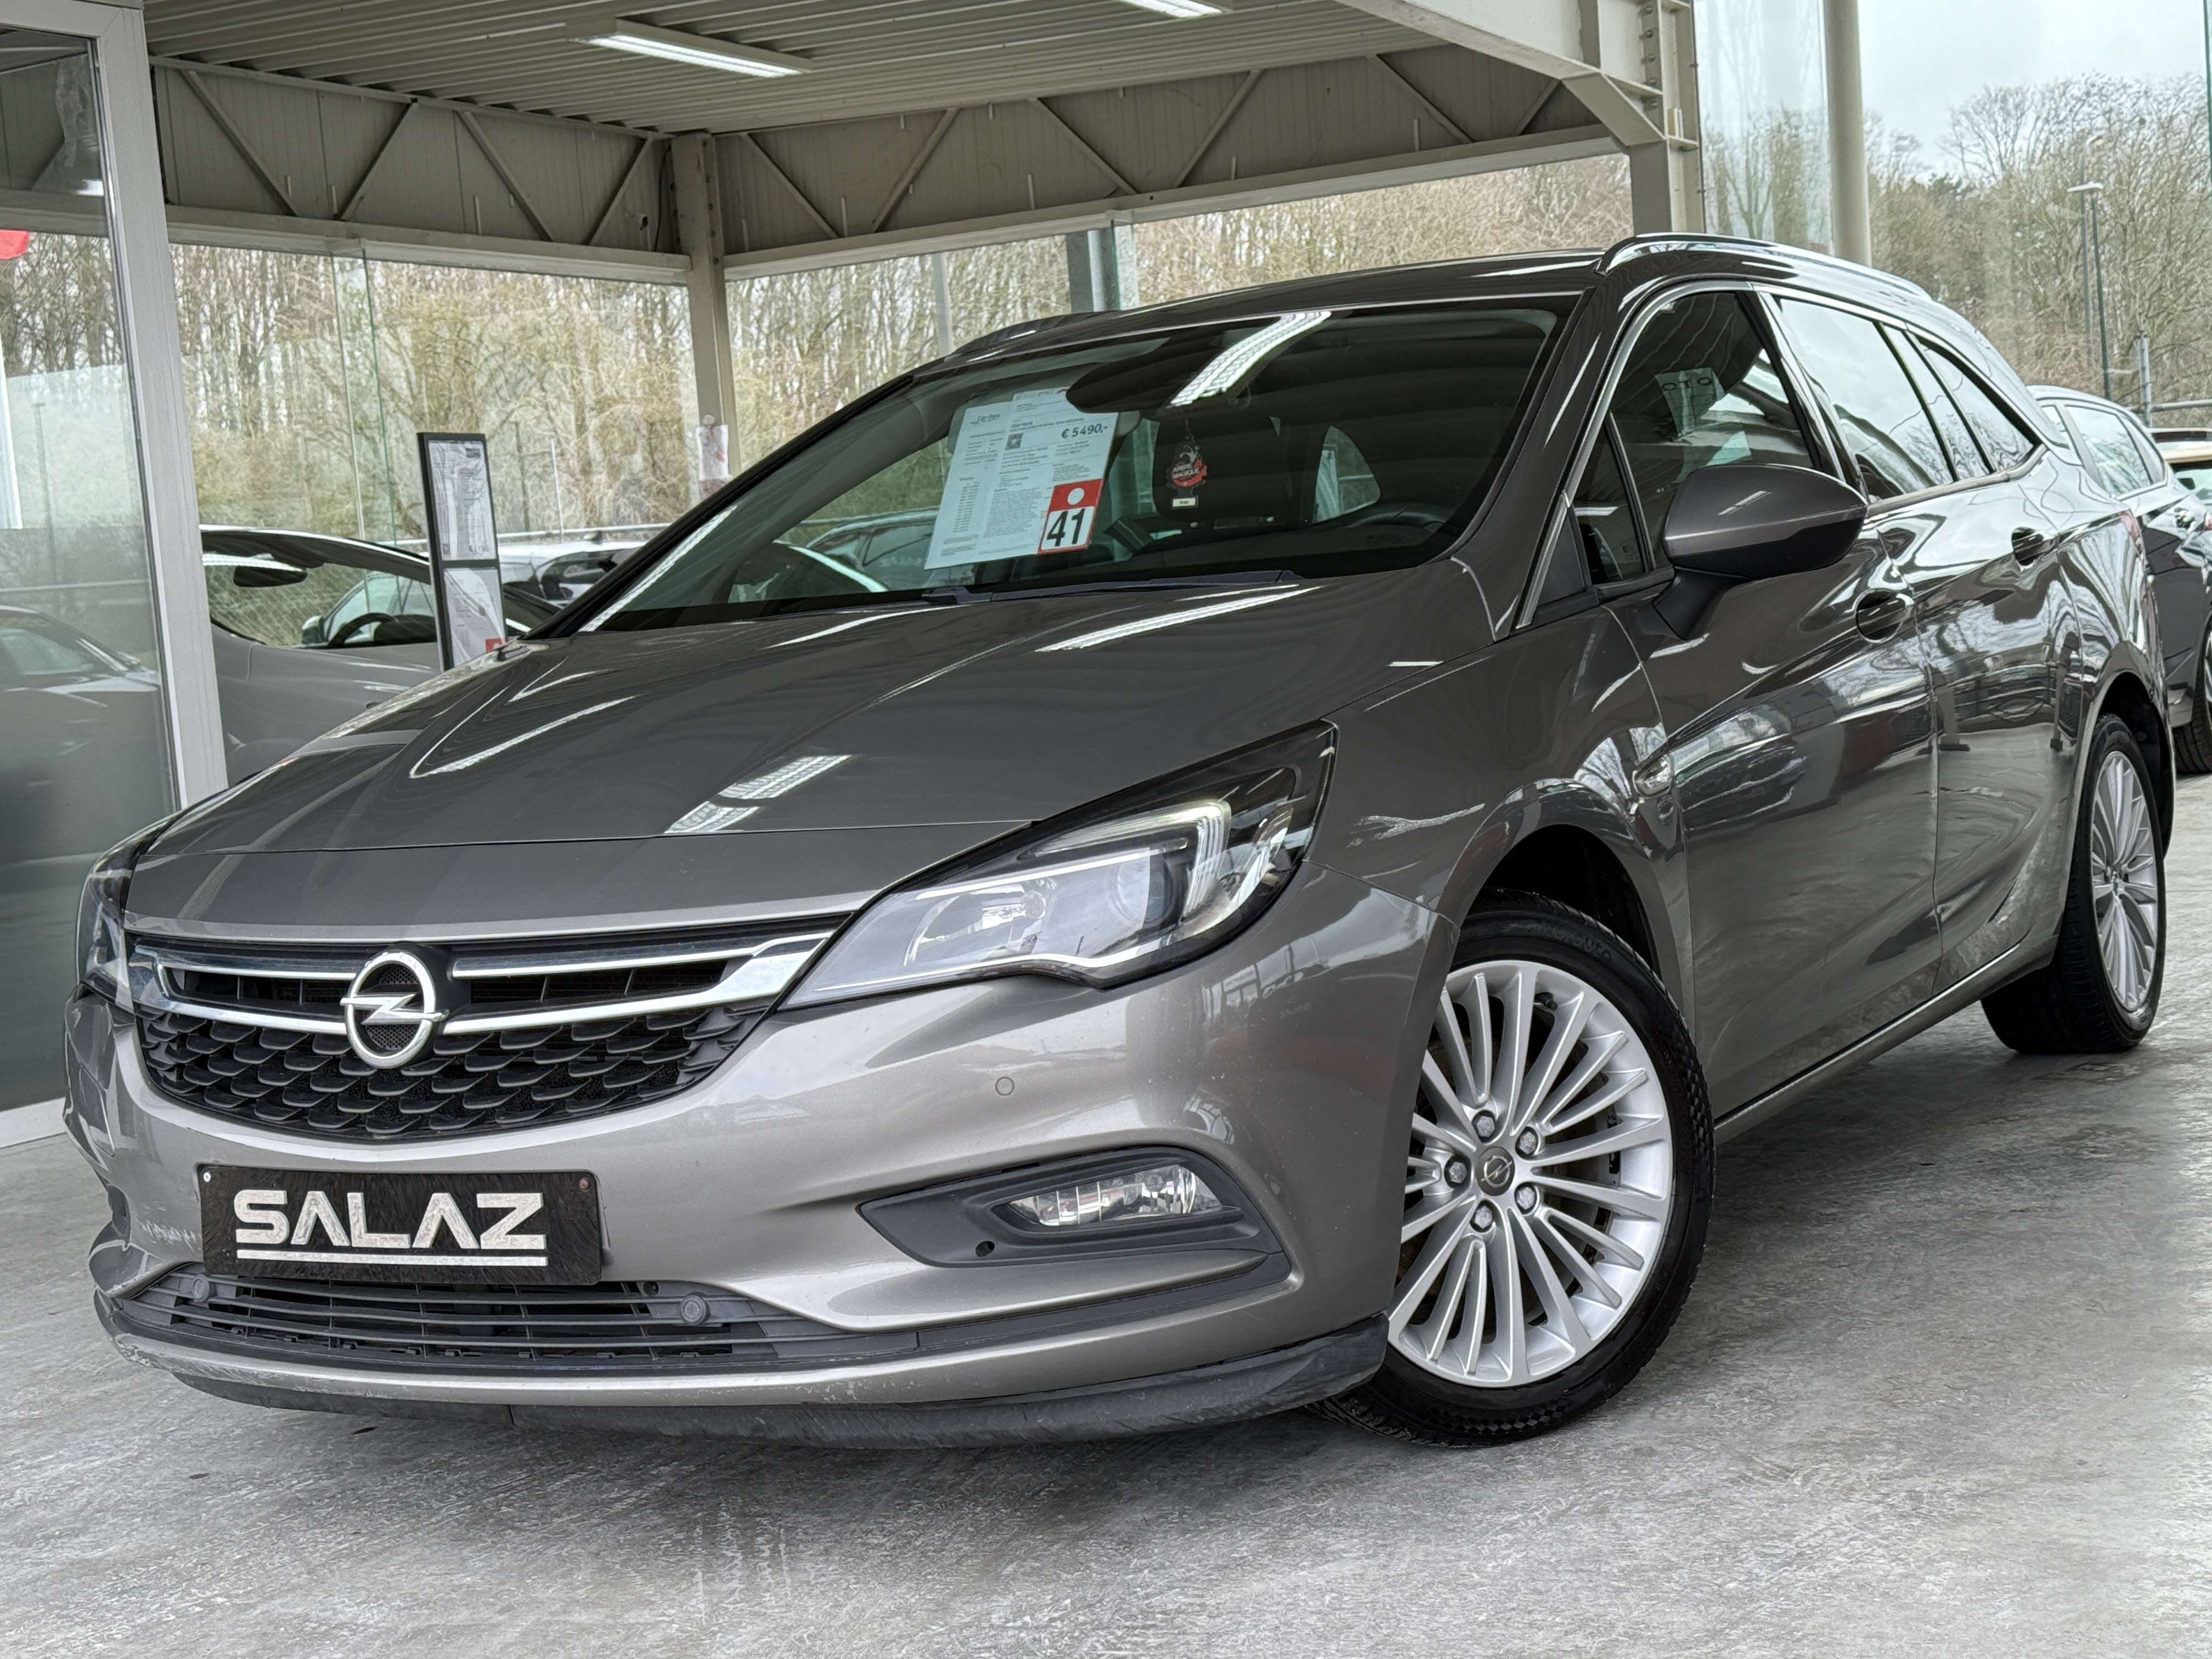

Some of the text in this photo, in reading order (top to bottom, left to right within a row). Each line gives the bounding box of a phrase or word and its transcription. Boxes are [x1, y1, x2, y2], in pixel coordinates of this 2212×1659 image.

[1062, 428, 1070, 438] €
[1047, 508, 1086, 547] 41
[234, 1189, 547, 1250] SALAZ
